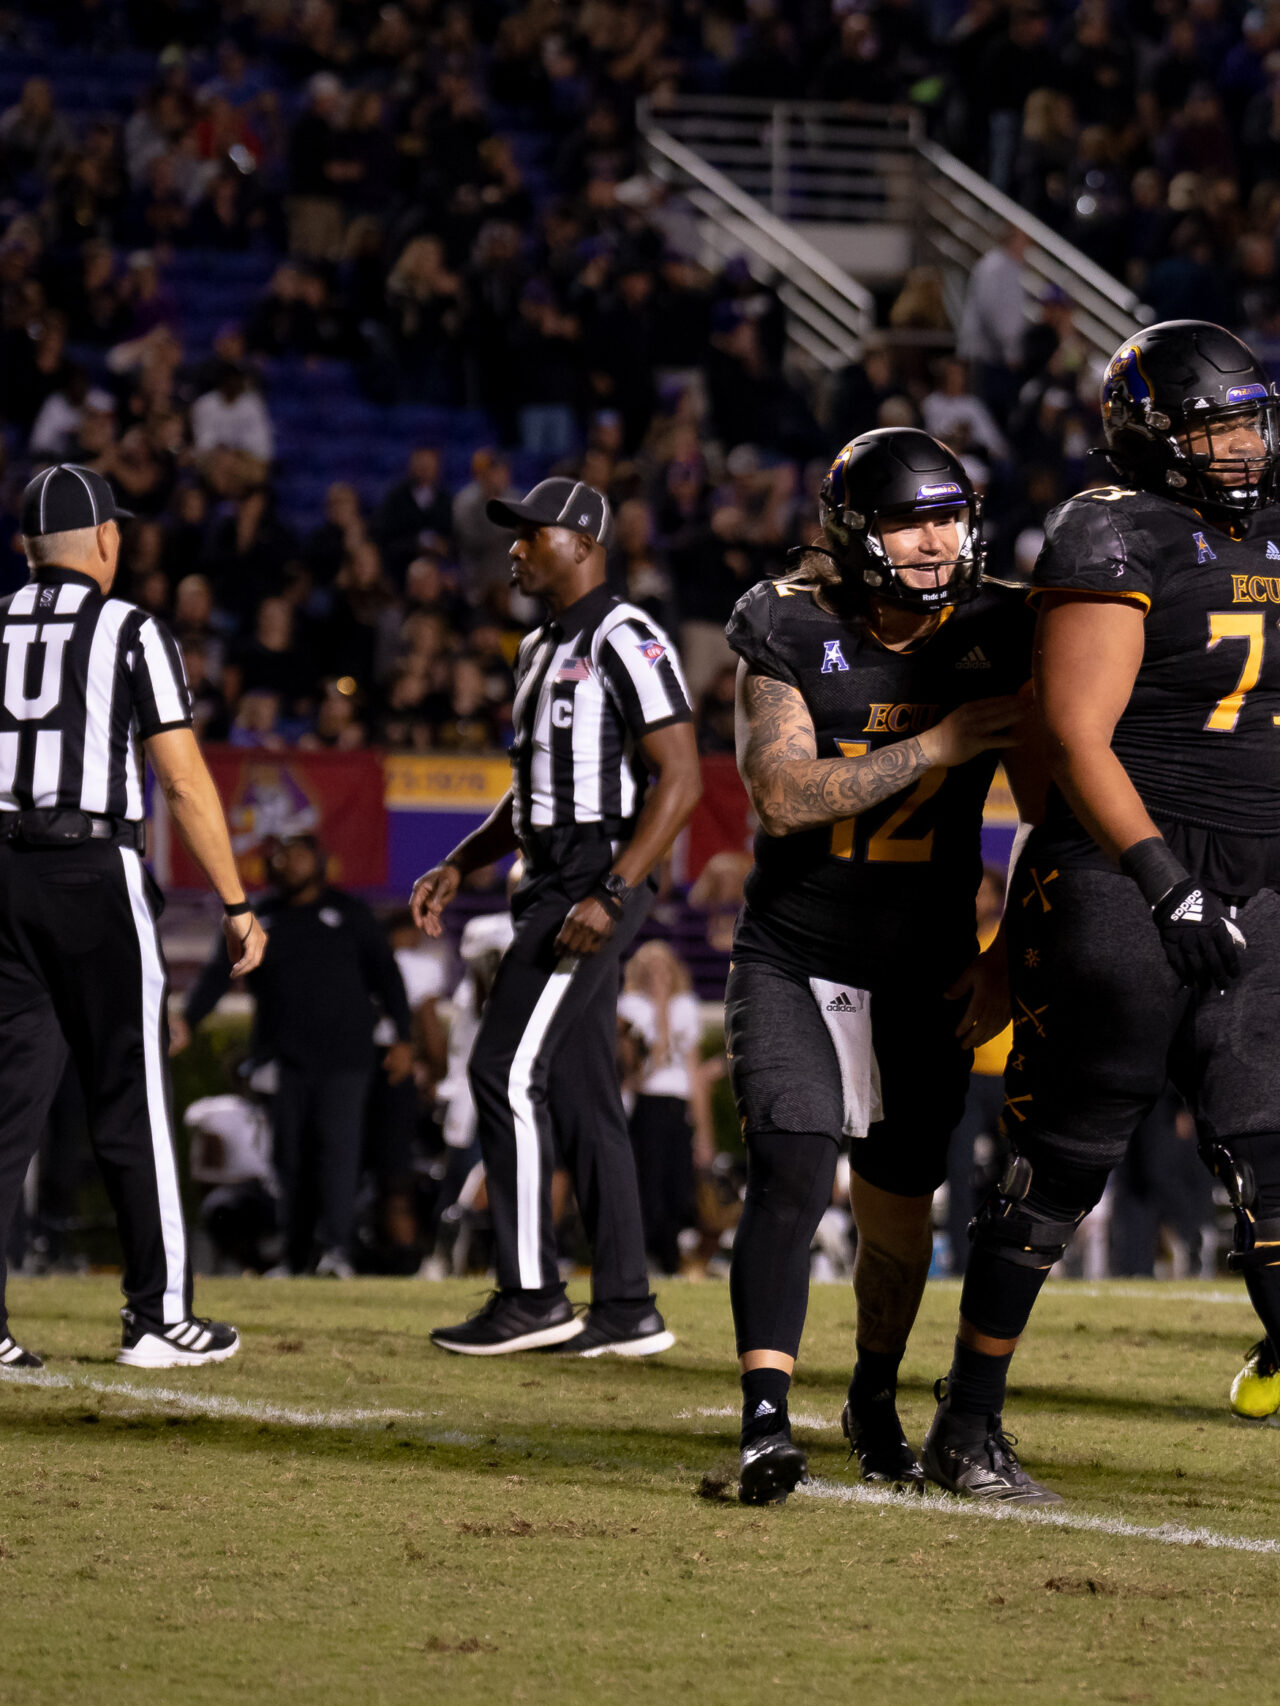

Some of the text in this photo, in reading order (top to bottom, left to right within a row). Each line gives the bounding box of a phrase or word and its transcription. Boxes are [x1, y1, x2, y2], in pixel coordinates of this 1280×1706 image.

[2, 622, 76, 722] U
[954, 659, 992, 670] adidas
[551, 699, 573, 729] C
[862, 703, 941, 733] ECU
[1170, 889, 1202, 922] adidas
[826, 1003, 857, 1013] adidas
